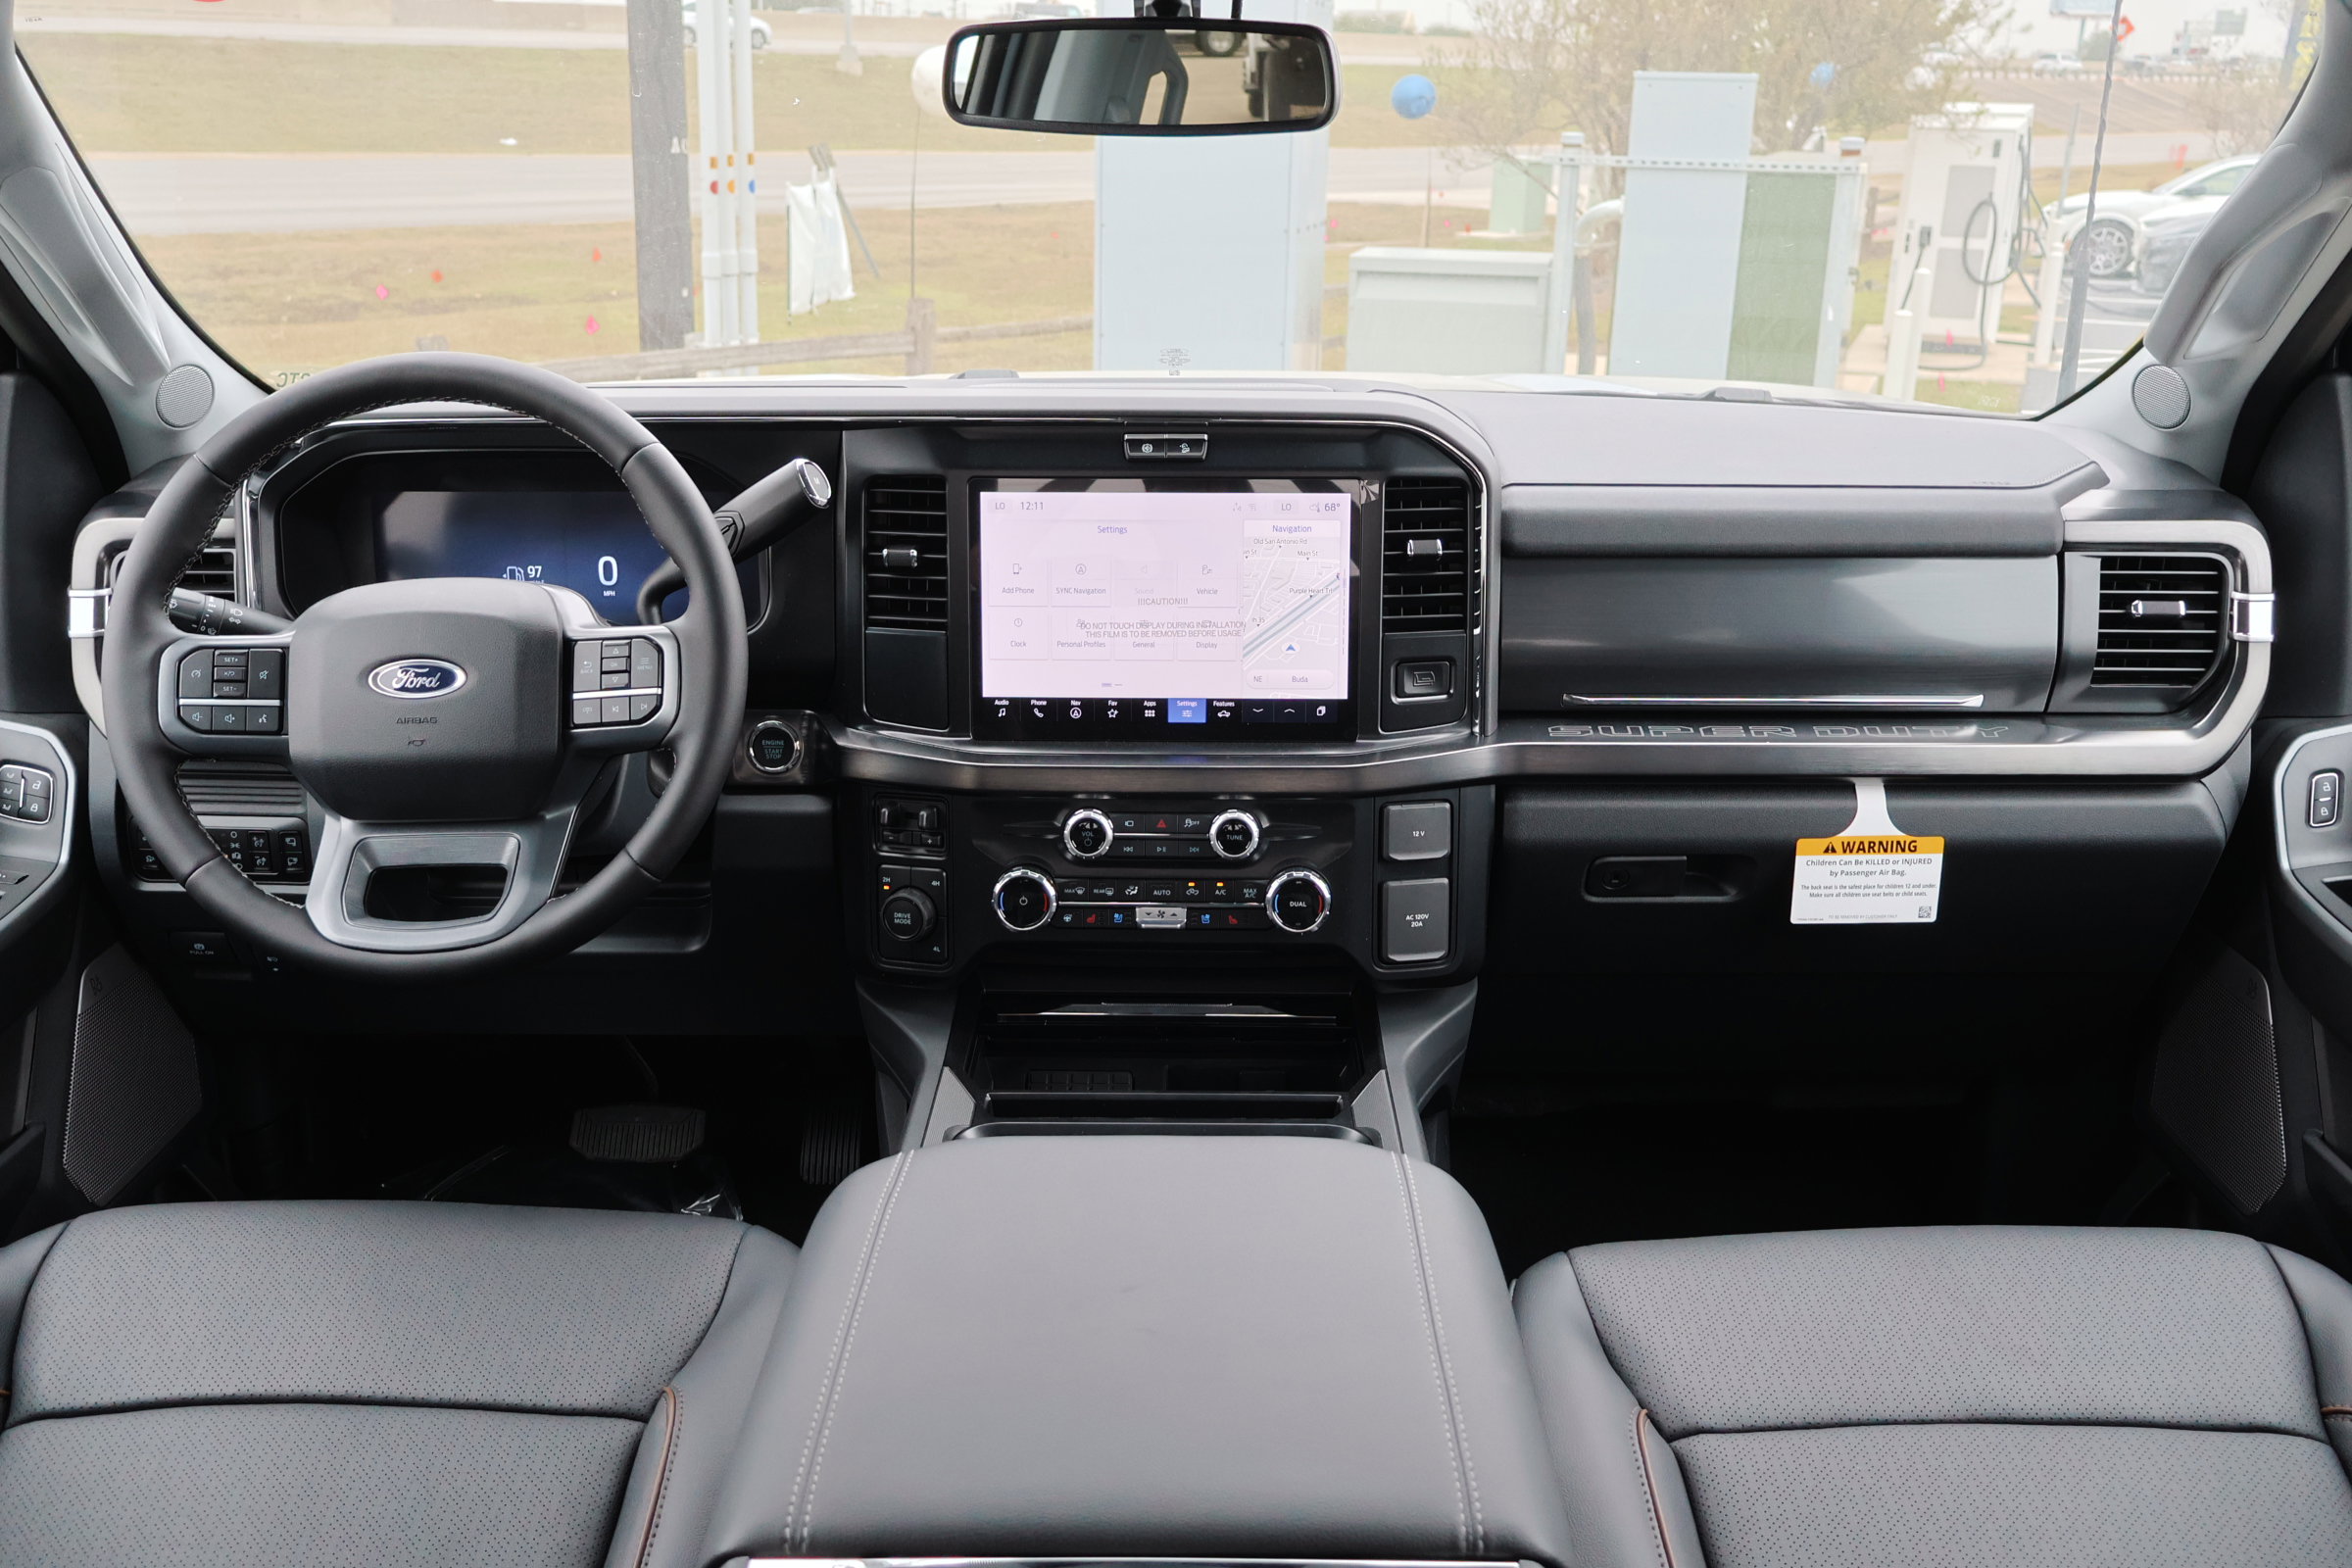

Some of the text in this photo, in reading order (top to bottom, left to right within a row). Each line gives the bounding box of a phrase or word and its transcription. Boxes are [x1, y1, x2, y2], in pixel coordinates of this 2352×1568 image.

[995, 502, 1005, 511] LO
[1020, 501, 1045, 511] 12:11
[1281, 503, 1292, 512] LO
[1324, 503, 1341, 512] 68°
[1097, 525, 1128, 534] Settings
[1272, 524, 1312, 534] Navigation
[527, 565, 542, 578] 97
[598, 556, 617, 586] 0
[1073, 587, 1106, 596] Navigation
[1135, 621, 1165, 630] DISPLAY
[1196, 620, 1247, 629] INSTALLATION
[1196, 641, 1218, 650] Display
[392, 666, 440, 689] Ford
[396, 716, 438, 725] AIRBAG
[1547, 724, 2009, 739] SUPER DUTY
[1841, 840, 1918, 854] WARNING
[1901, 858, 1933, 866] INJURED
[1830, 869, 1839, 878] by
[1840, 869, 1877, 878] Passenger
[1891, 868, 1907, 877] Bag.
